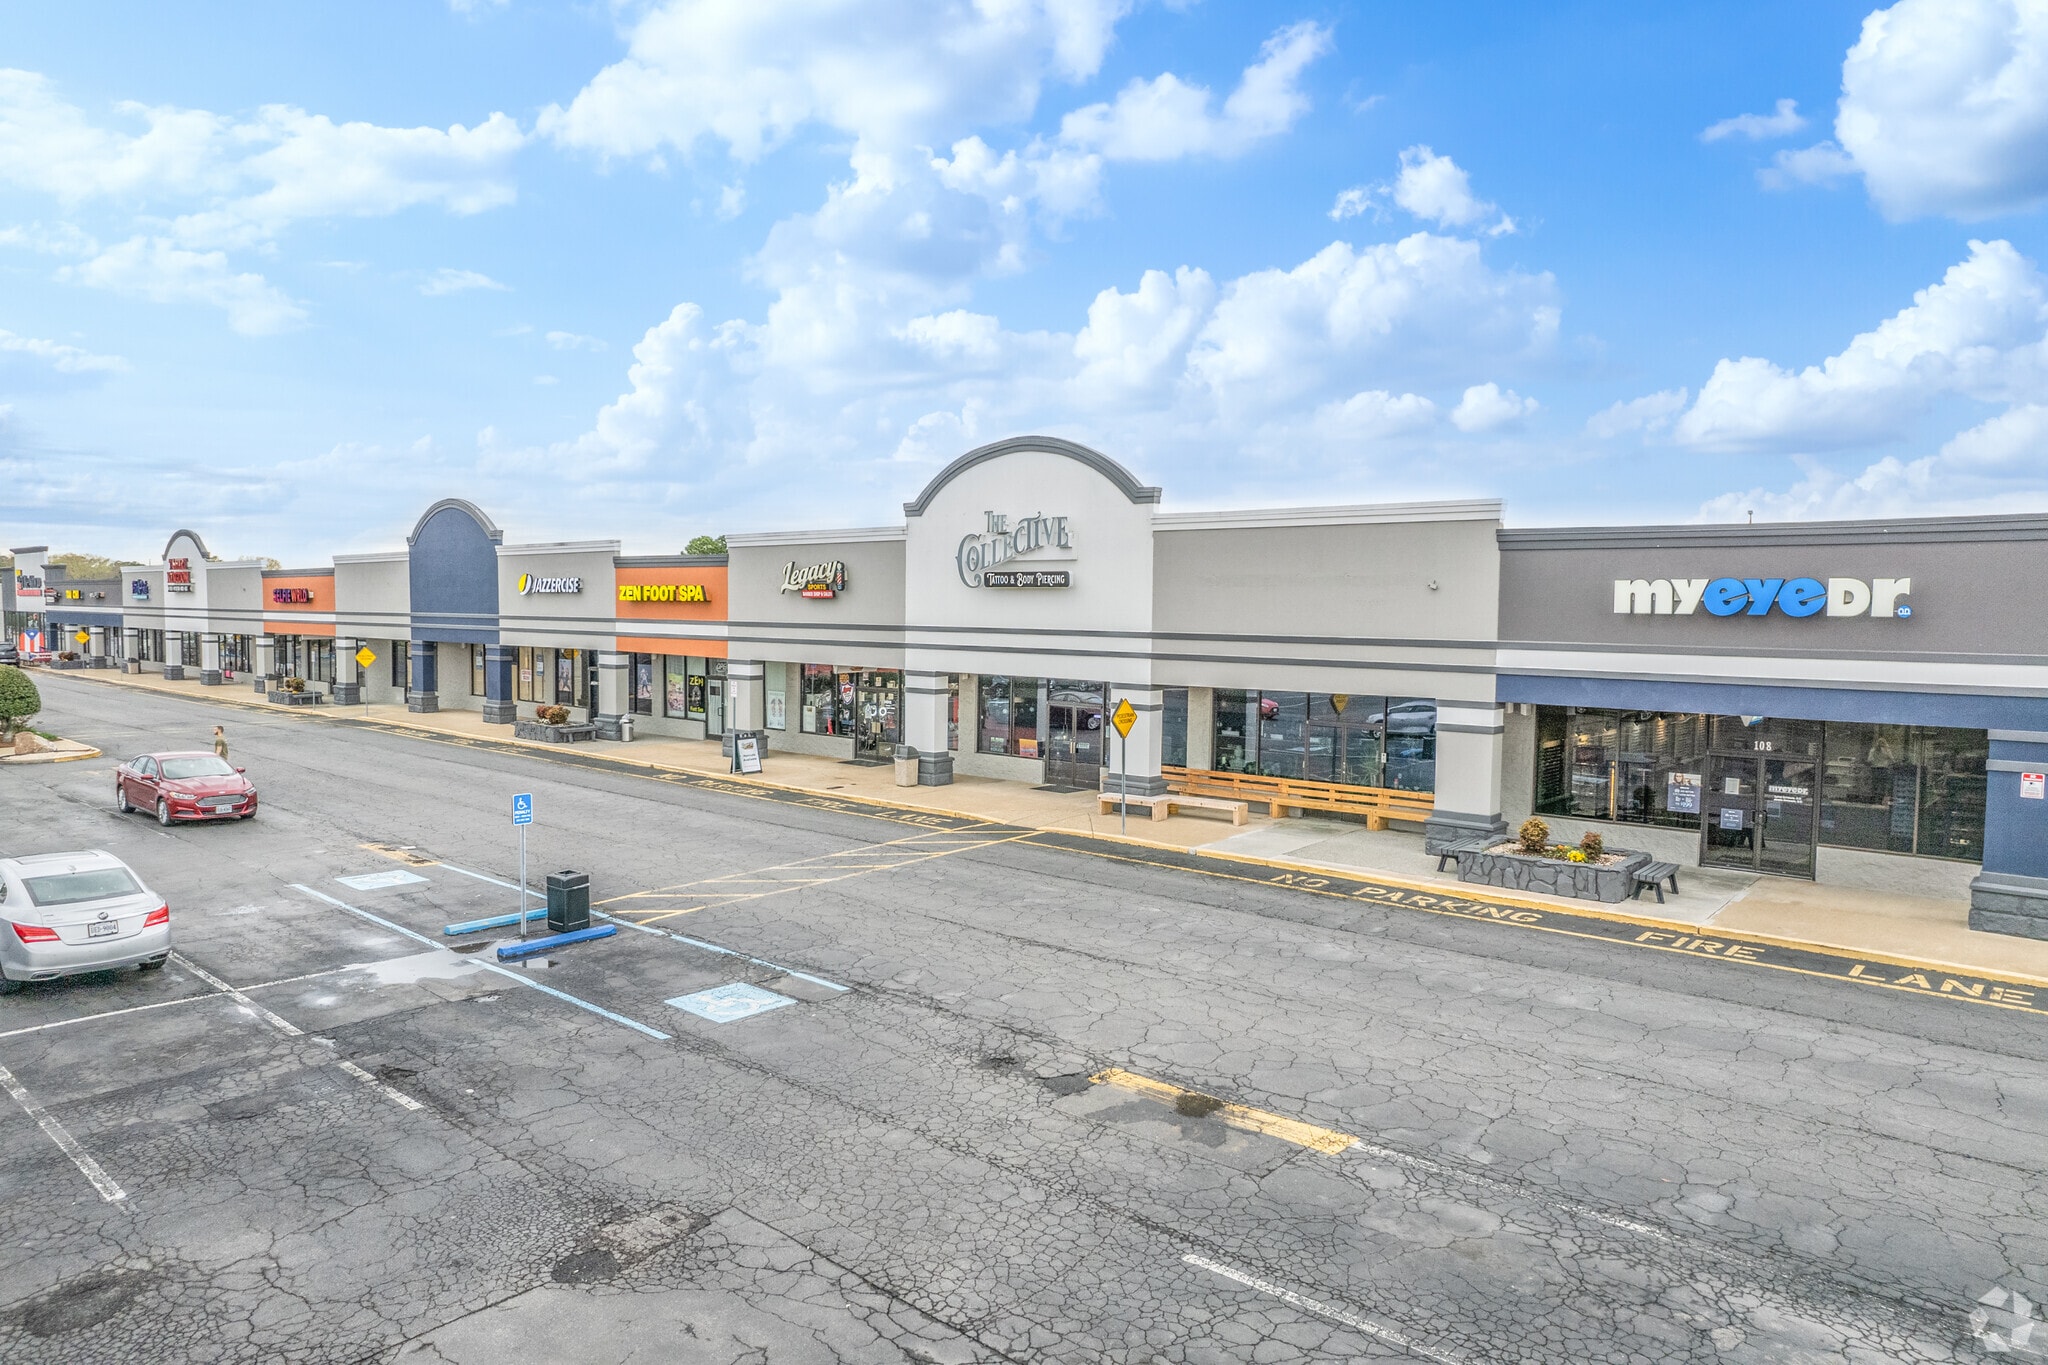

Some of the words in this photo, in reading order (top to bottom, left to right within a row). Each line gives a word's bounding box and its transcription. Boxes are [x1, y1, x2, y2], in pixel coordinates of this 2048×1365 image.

[780, 560, 837, 592] Legacy
[1010, 575, 1015, 584] &
[532, 577, 579, 593] JAZZERCISE
[619, 585, 642, 601] ZEN
[643, 585, 676, 601] FOOT
[679, 585, 704, 601] SPA
[690, 676, 704, 687] ZEN
[1753, 741, 1772, 752] 108
[1270, 873, 1330, 888] NO
[1352, 886, 1544, 923] PARKING
[1635, 930, 1765, 960] FIRE
[1847, 964, 2036, 1006] LANE
